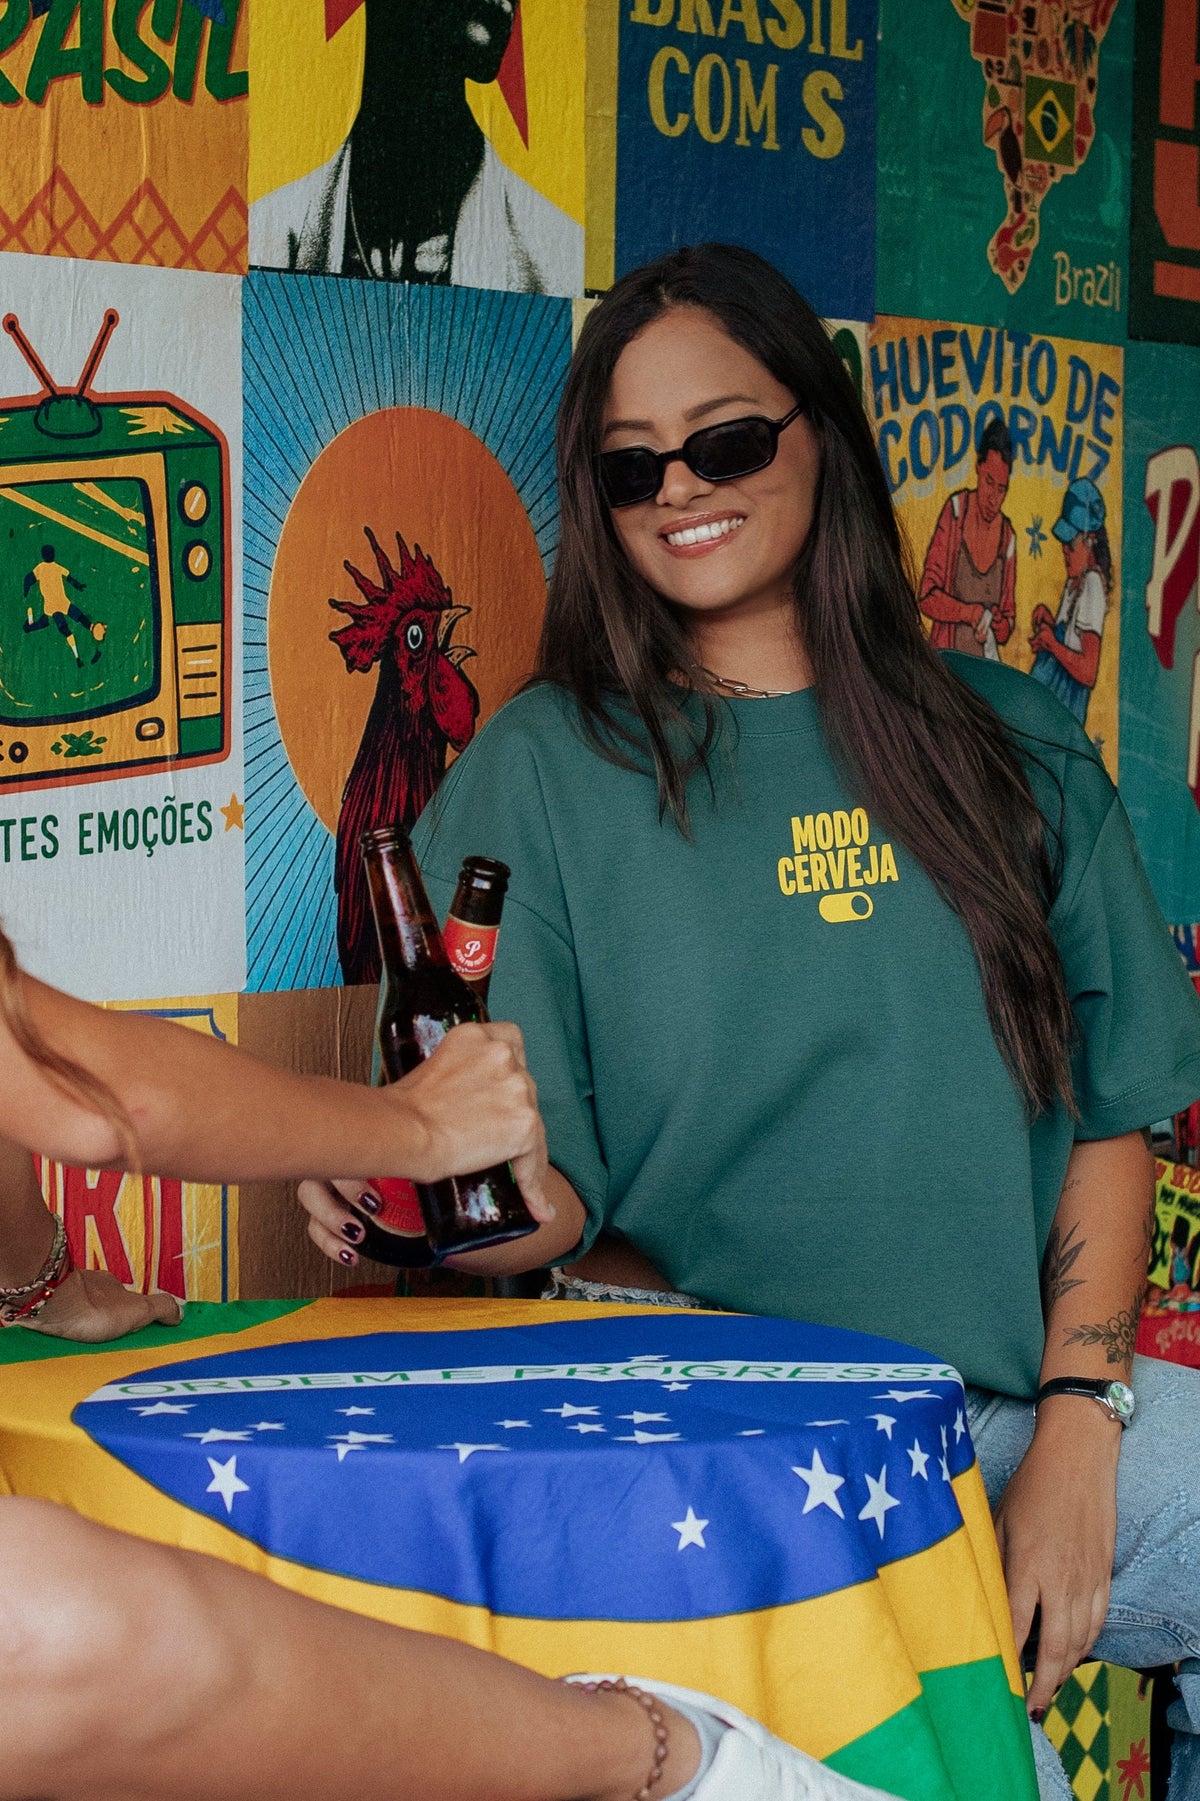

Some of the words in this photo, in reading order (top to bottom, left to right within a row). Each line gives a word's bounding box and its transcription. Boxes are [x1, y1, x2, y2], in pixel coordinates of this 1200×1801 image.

[648, 45, 781, 151] COM
[801, 70, 846, 160] S
[1052, 250, 1121, 312] Brazil
[869, 328, 1058, 419] HUEVITO
[1066, 355, 1121, 446] DE
[0, 814, 59, 863] TES
[79, 795, 213, 858] EMOÇÕES
[790, 807, 870, 854] MODO
[777, 843, 899, 896] CERVEJA
[118, 1372, 411, 1395] ORDEM
[441, 1369, 485, 1380] E
